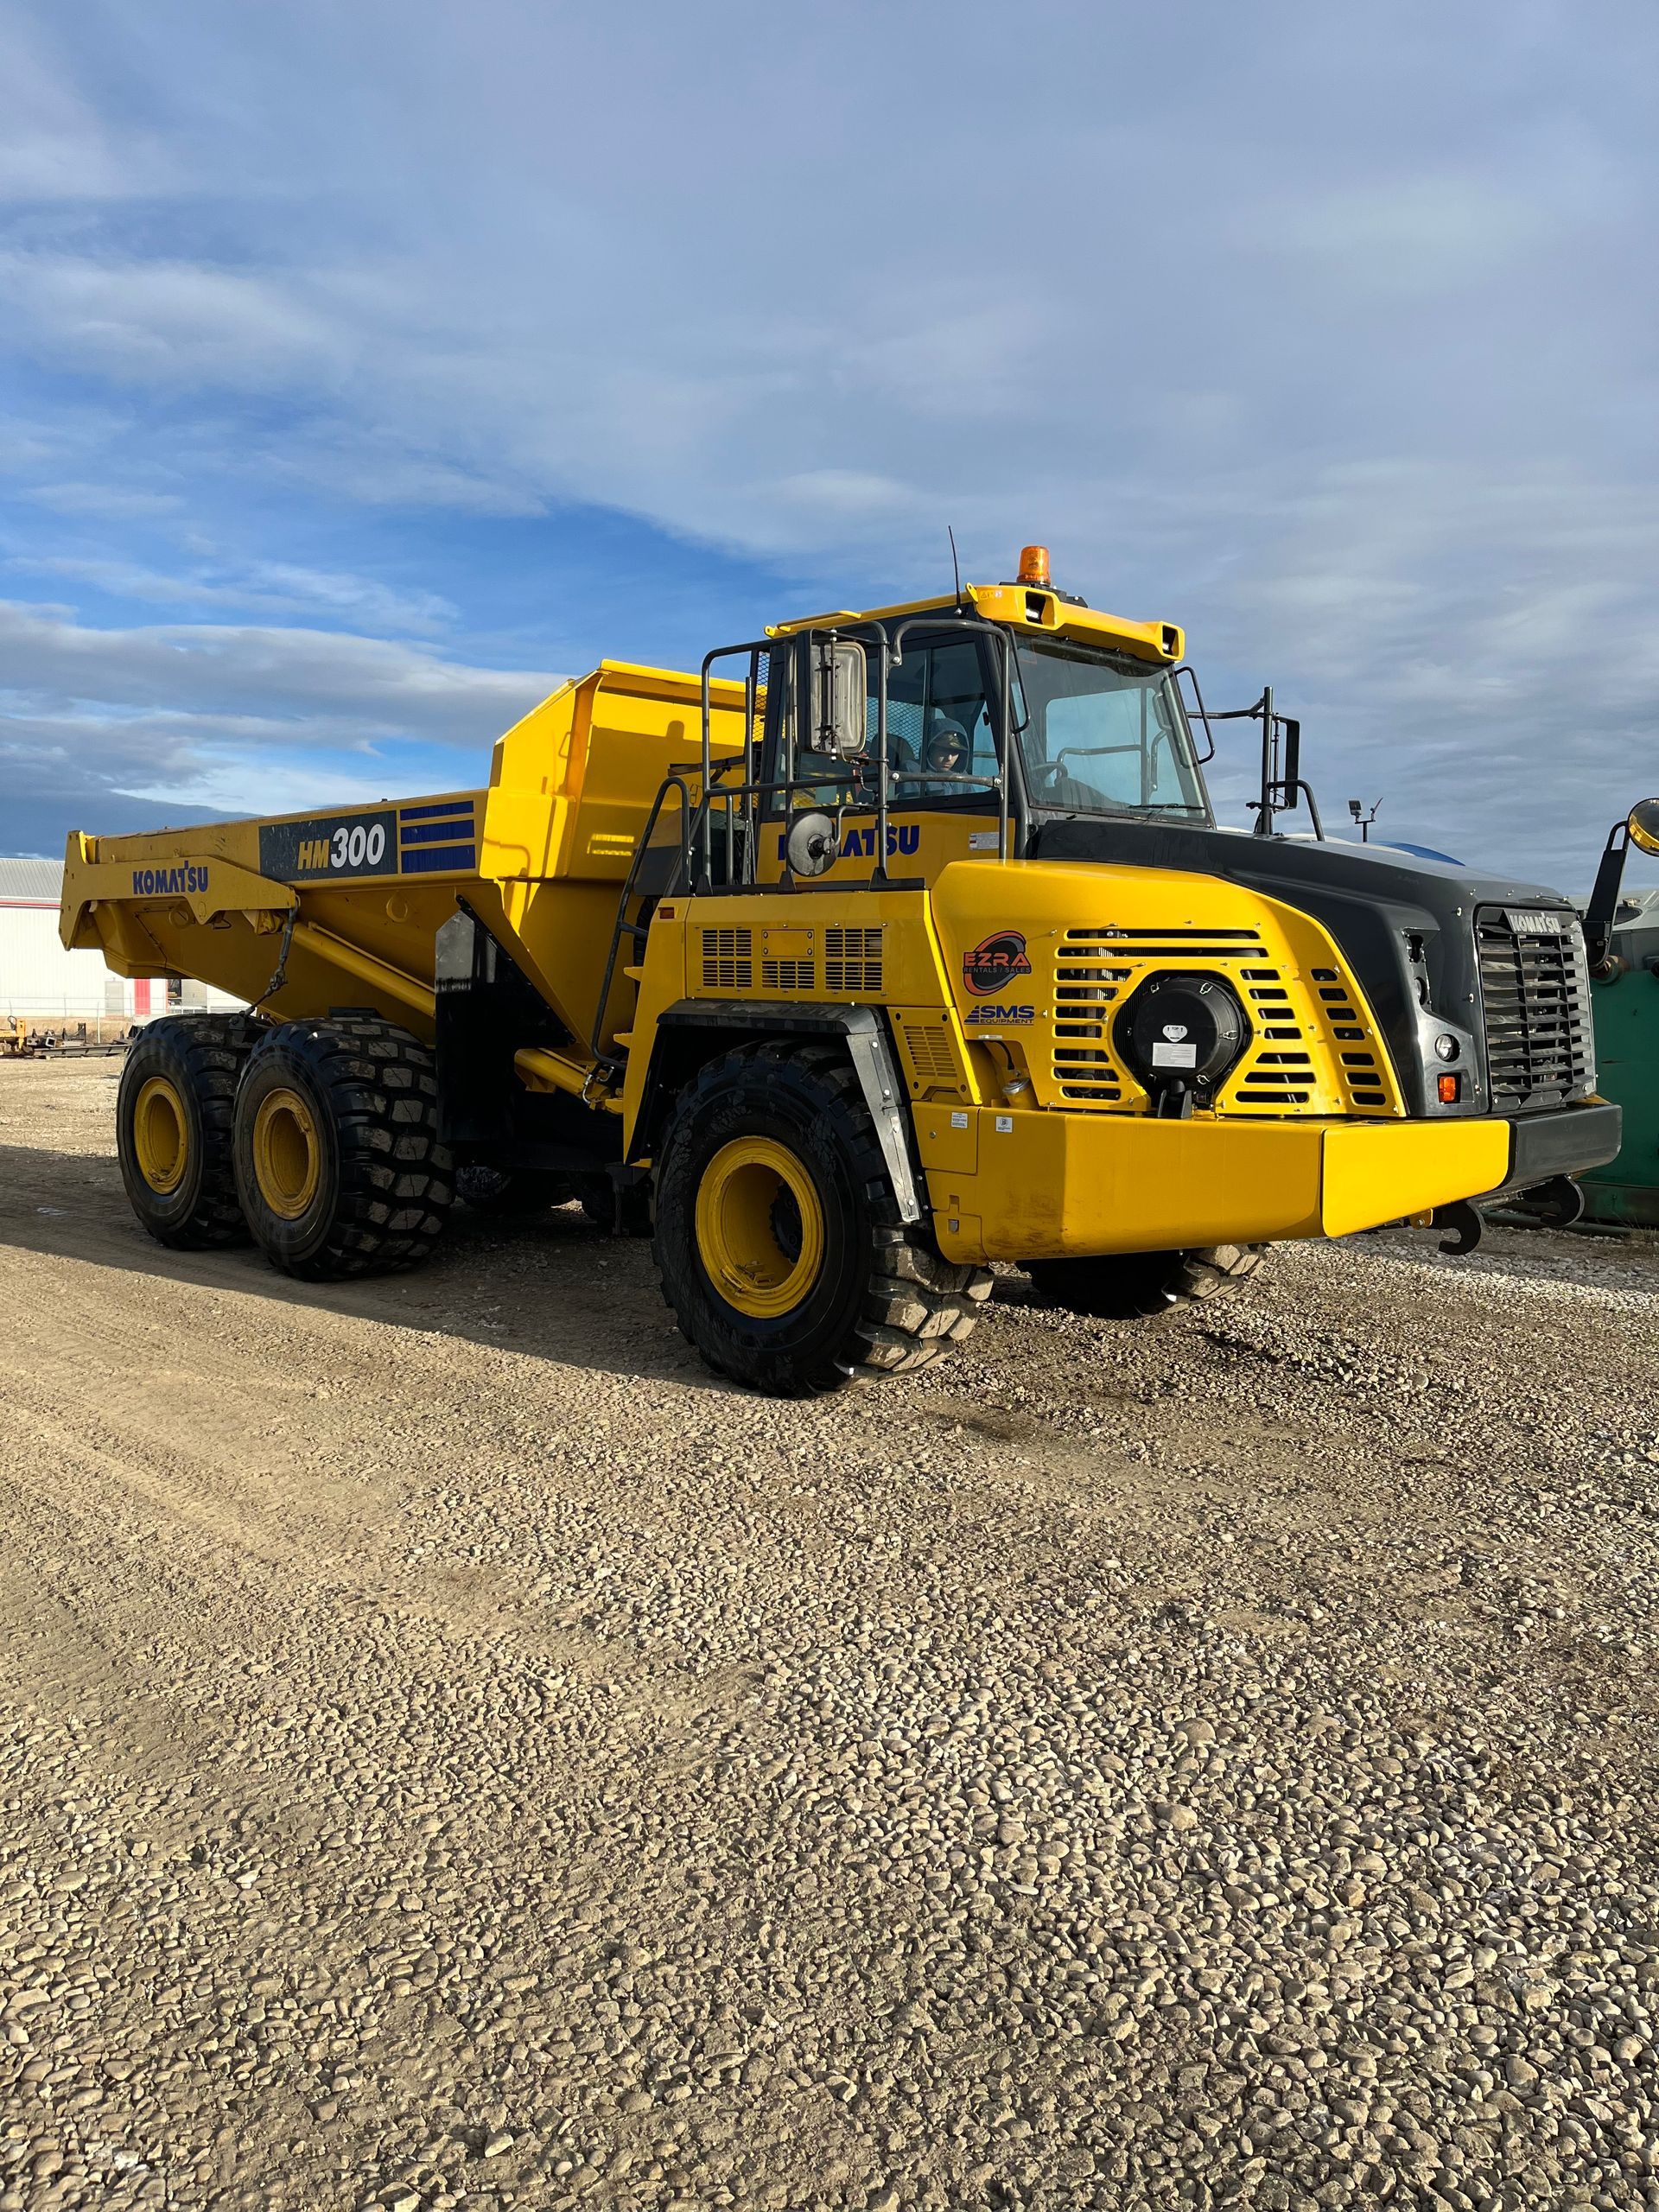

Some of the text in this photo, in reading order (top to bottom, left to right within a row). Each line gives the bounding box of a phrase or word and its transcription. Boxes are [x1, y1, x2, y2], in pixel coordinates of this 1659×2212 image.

[778, 819, 920, 861] ATSU
[132, 860, 208, 895] KOMATSU
[1509, 912, 1561, 934] KOMATSU
[964, 952, 1031, 967] EZRA
[980, 1005, 1035, 1019] SMS
